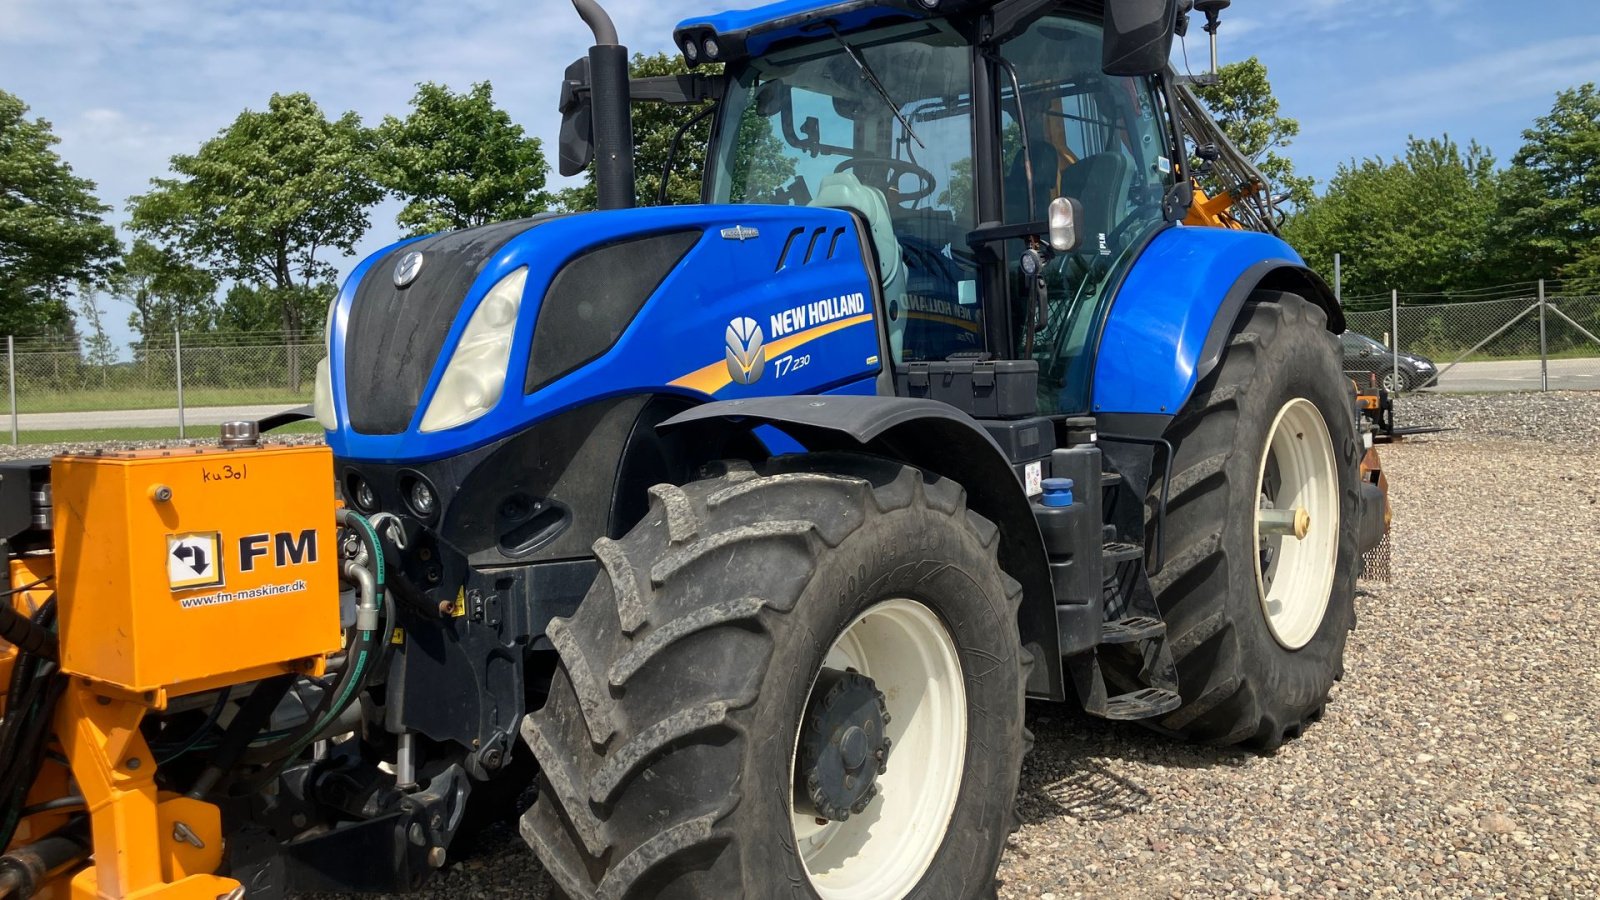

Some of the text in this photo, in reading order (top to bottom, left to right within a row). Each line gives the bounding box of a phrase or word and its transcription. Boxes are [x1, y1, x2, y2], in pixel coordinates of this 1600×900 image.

[1098, 233, 1106, 249] PLM
[770, 292, 865, 338] NEW HOLLAND
[239, 529, 317, 571] FM
[181, 580, 306, 608] www.fm-maskiner.dk
